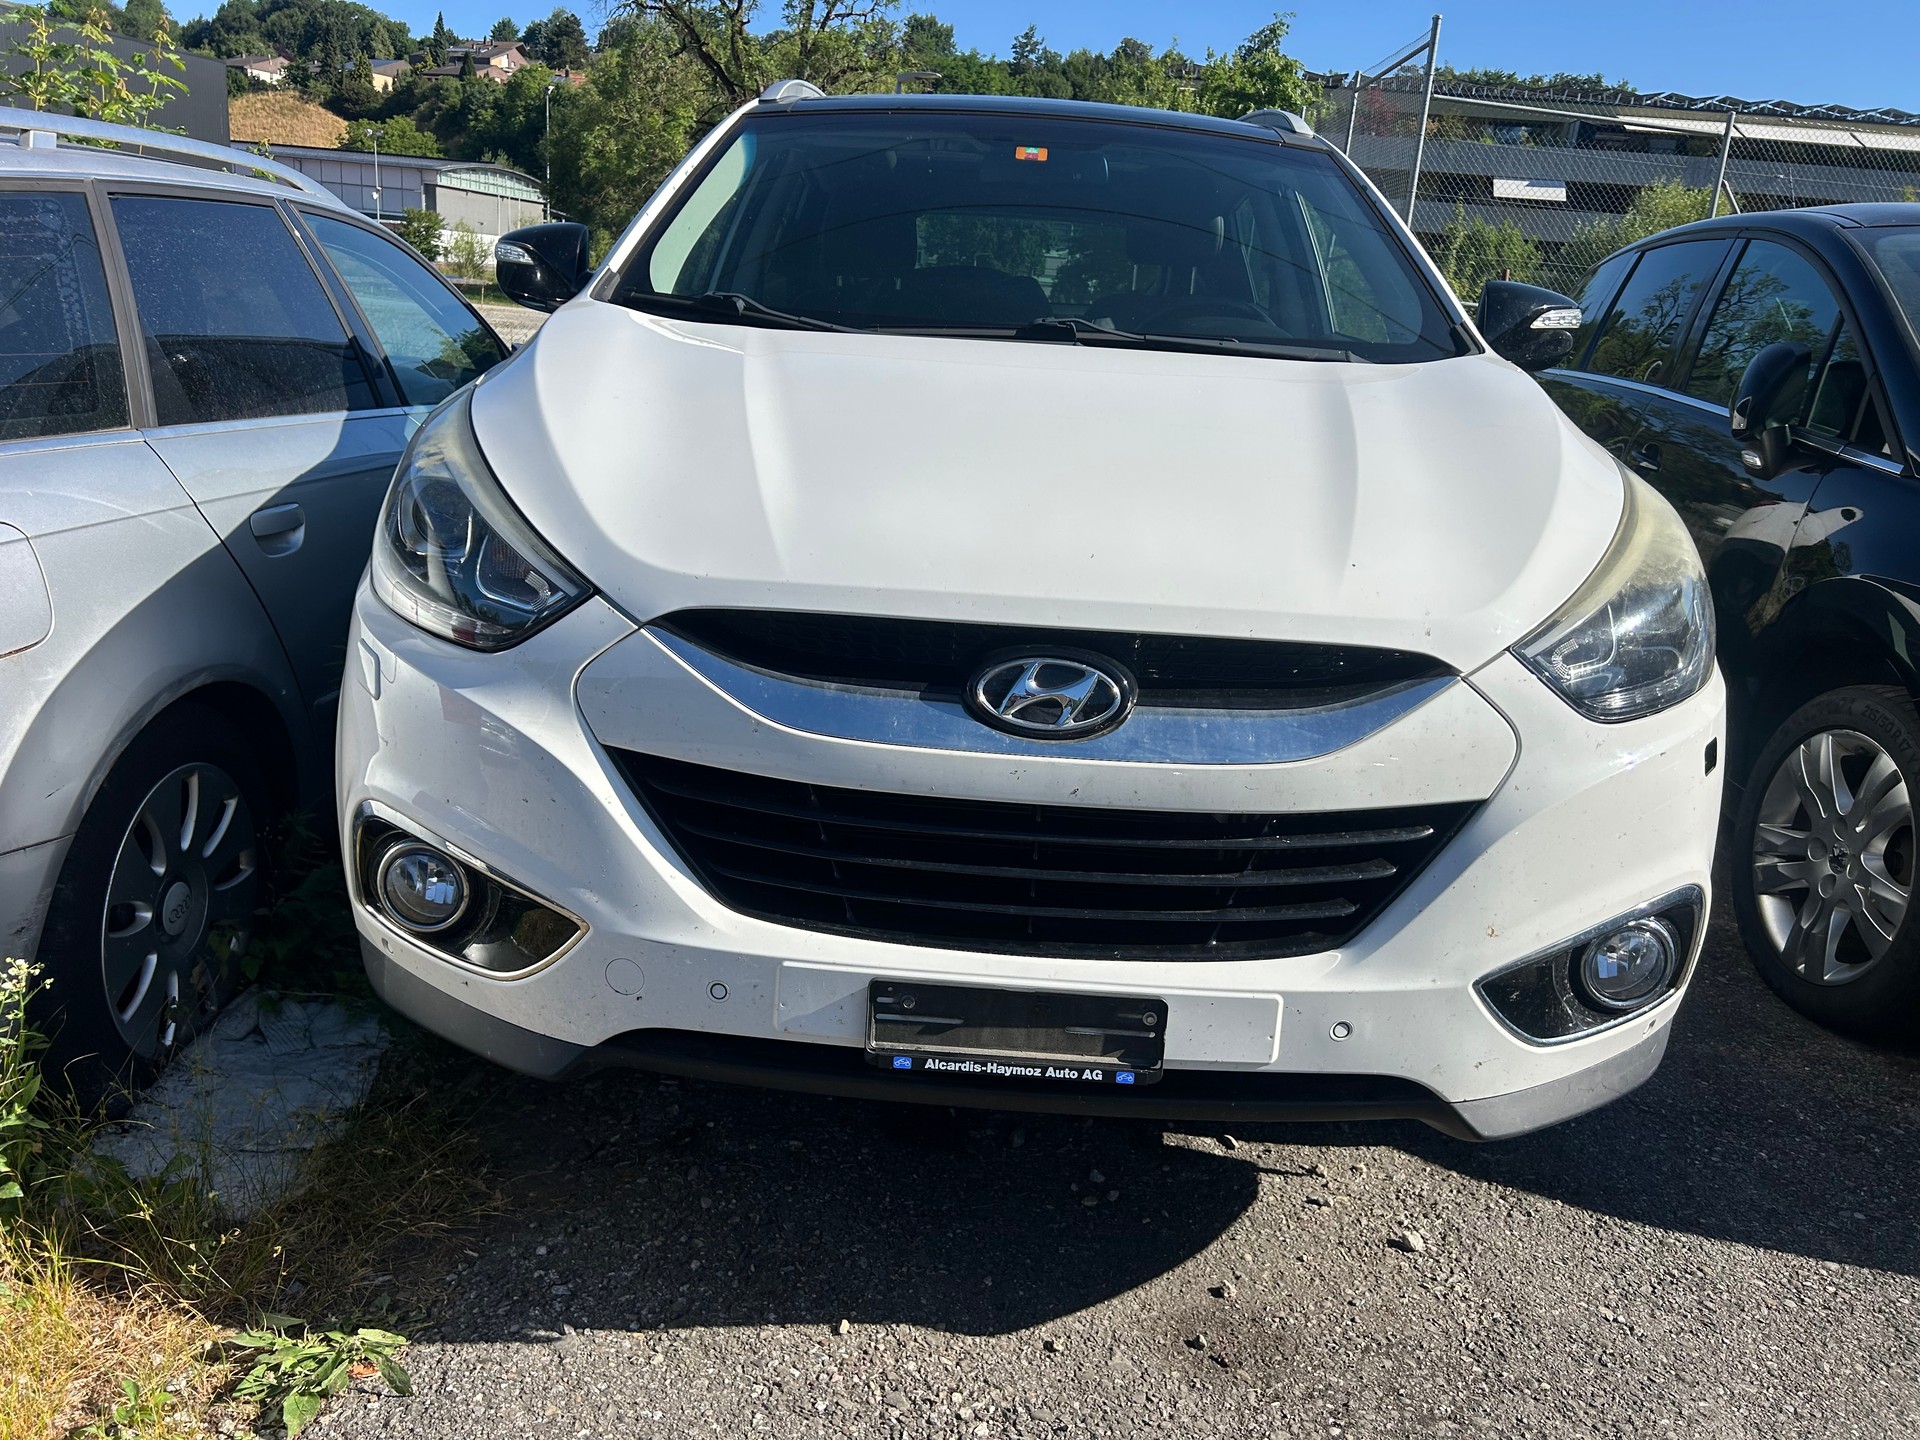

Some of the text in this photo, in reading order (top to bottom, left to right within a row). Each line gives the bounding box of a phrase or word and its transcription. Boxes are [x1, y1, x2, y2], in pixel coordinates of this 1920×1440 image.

[924, 1058, 1103, 1081] Alcardis-Haymoz Auto AG
